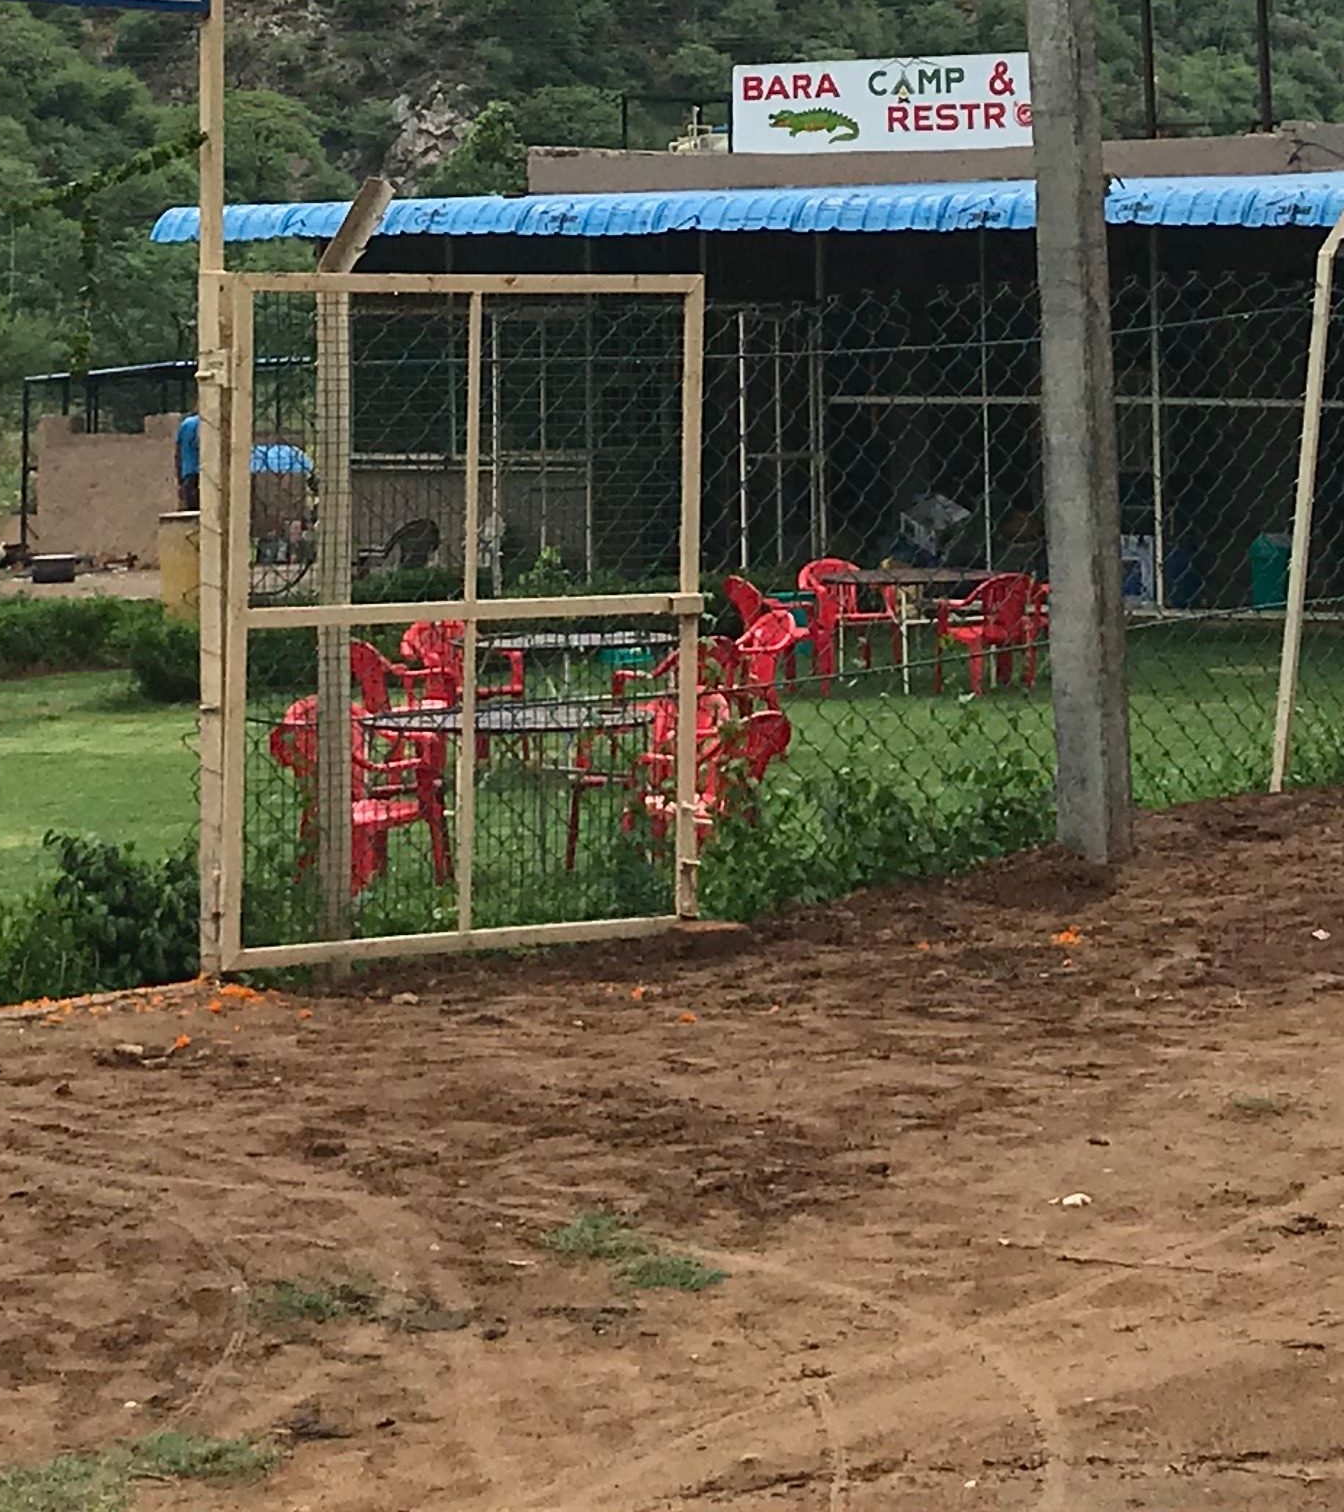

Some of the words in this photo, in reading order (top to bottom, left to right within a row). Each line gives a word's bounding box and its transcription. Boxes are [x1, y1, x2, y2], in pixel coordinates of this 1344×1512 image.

[742, 73, 841, 101] BARA
[868, 67, 965, 97] CAMP
[989, 60, 1016, 96] &
